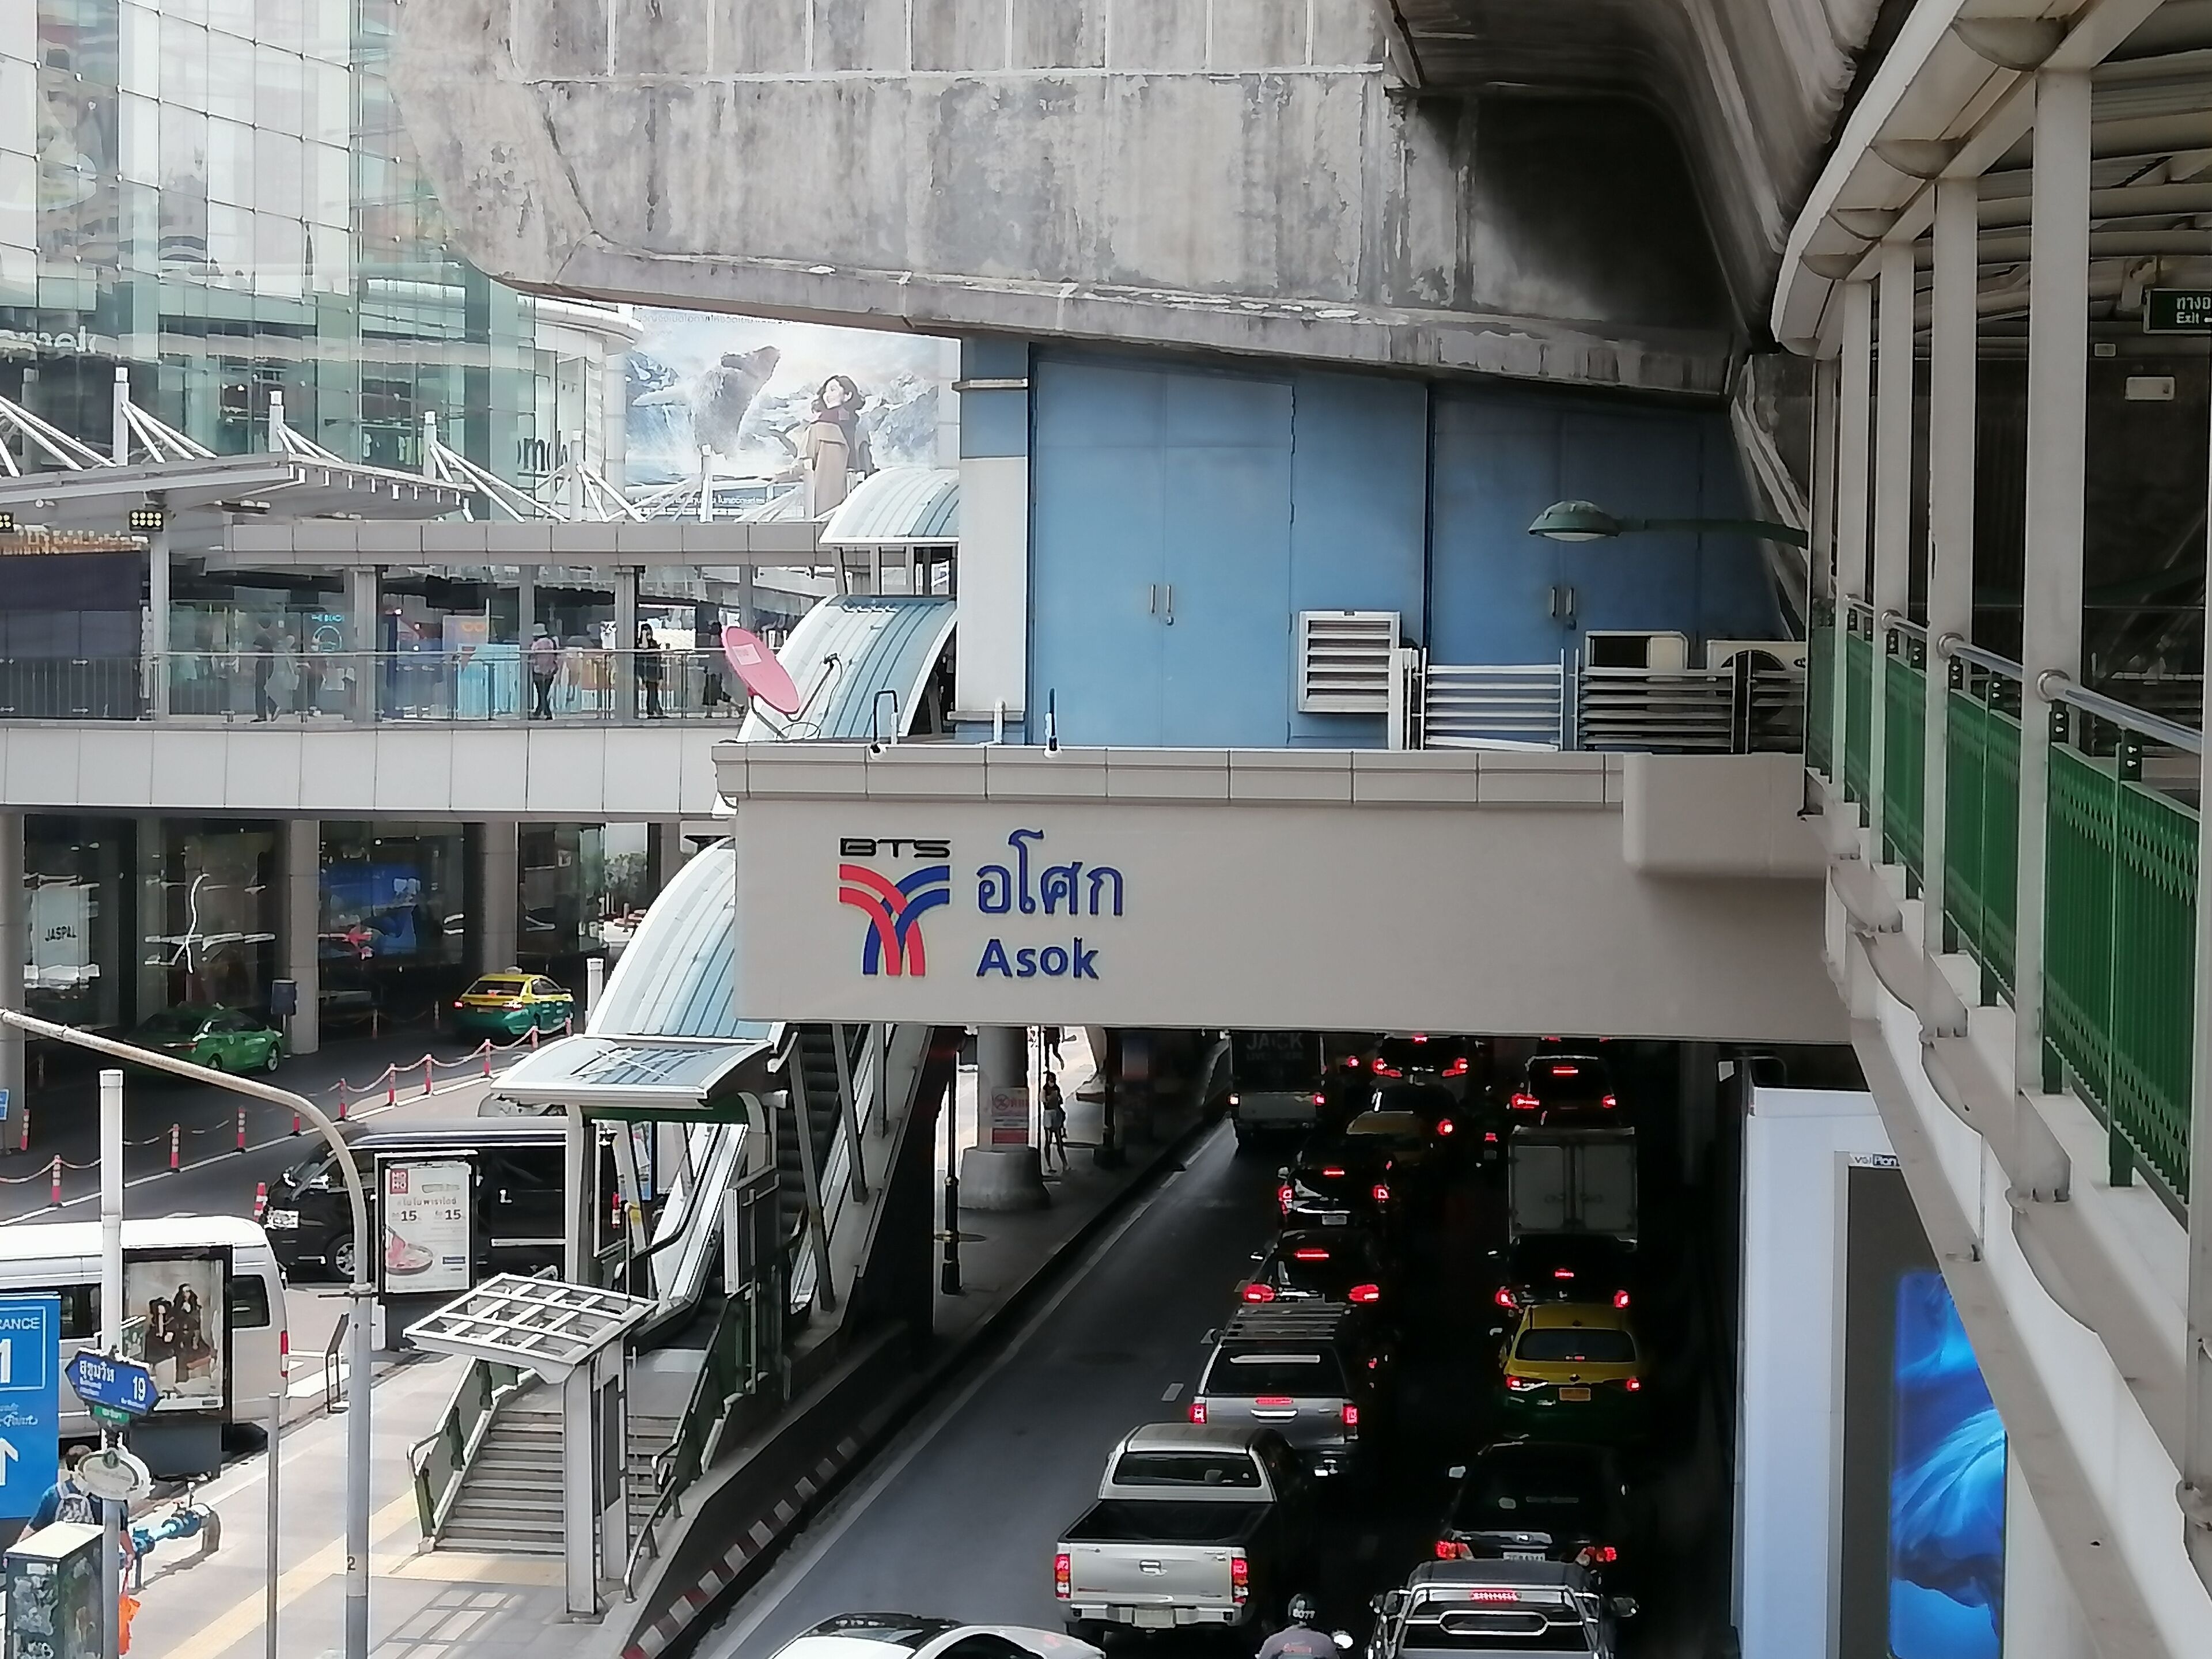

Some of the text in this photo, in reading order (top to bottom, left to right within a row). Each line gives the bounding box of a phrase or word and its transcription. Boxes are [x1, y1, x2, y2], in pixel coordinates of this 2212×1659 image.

[2177, 312, 2199, 324] Exit
[840, 838, 951, 858] BTS
[976, 828, 1123, 916] อโศก
[976, 937, 1100, 980] Asok
[401, 1210, 417, 1221] 15
[445, 1209, 461, 1220] 15
[133, 1376, 146, 1401] 19
[347, 1556, 356, 1571] 2
